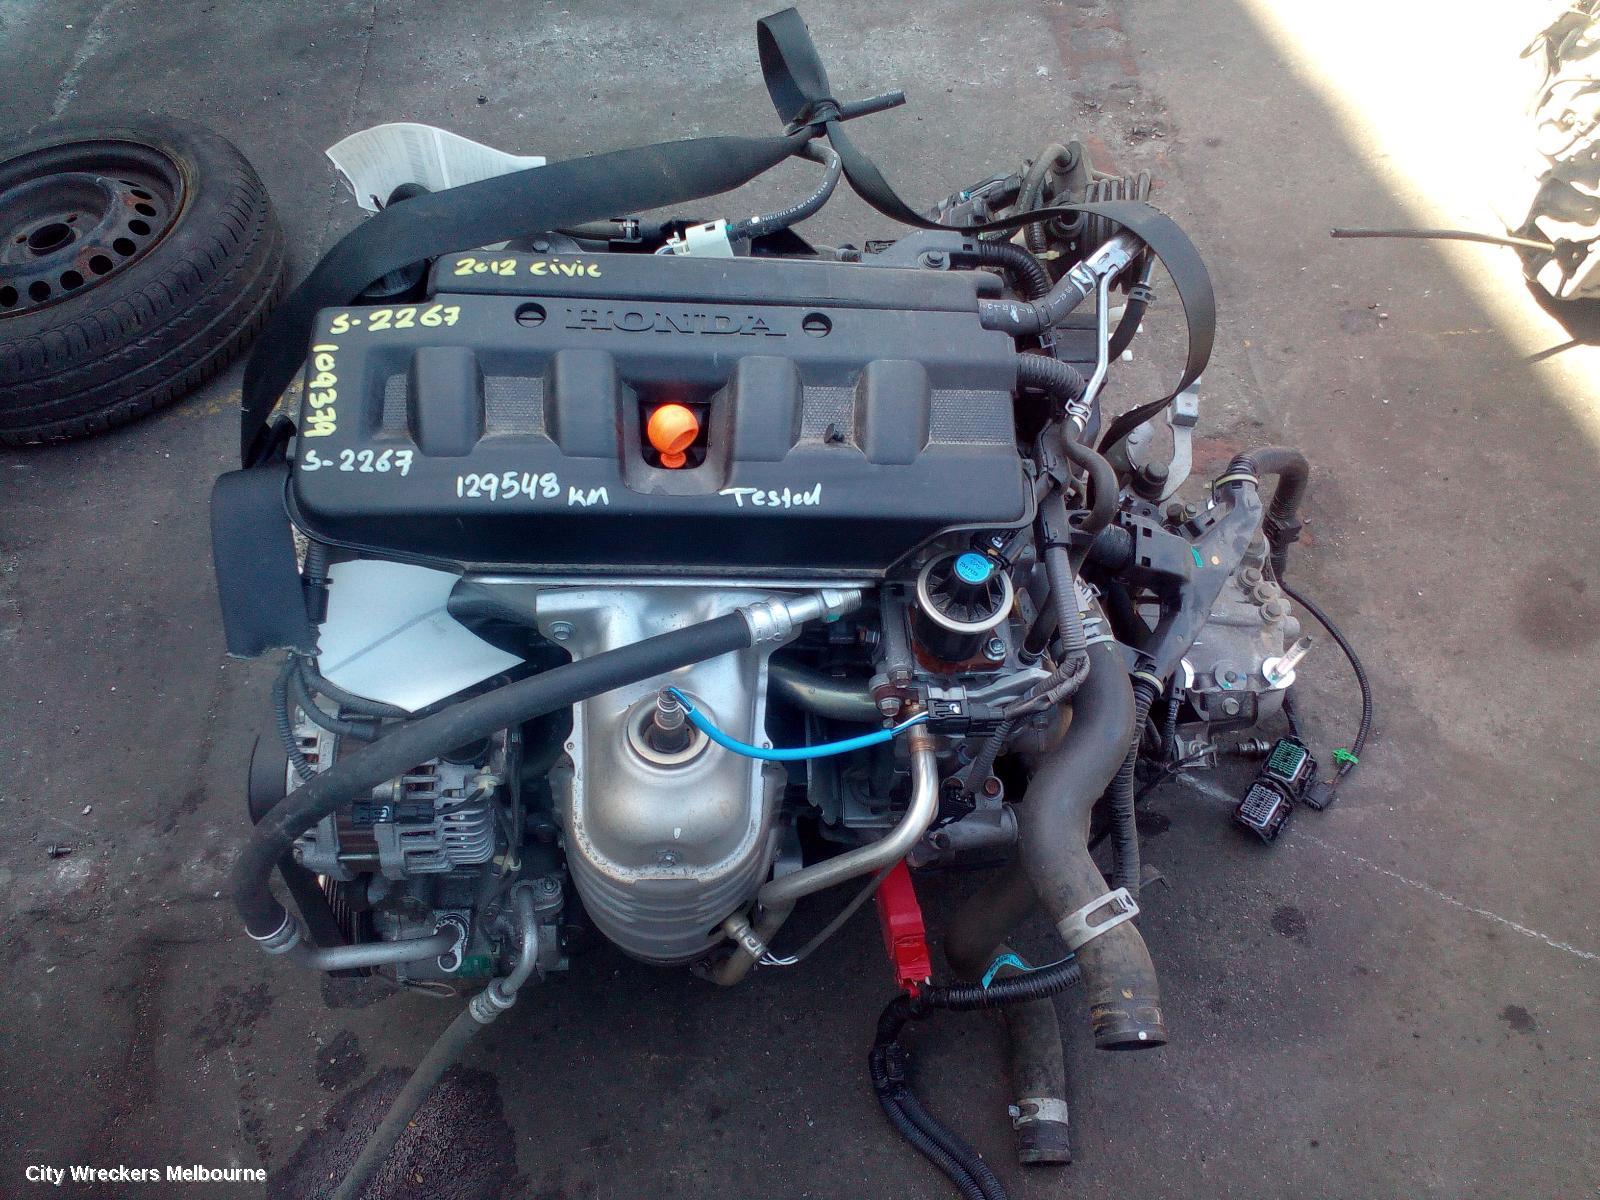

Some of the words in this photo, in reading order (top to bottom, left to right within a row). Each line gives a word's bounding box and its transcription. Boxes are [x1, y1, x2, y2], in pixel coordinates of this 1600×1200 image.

[454, 257, 518, 276] 2012
[329, 303, 462, 335] S-2267
[565, 308, 788, 337] HONDA
[300, 343, 340, 438] 109379
[300, 447, 414, 477] S-2267
[456, 470, 561, 502] 129548
[718, 482, 822, 509] Tested
